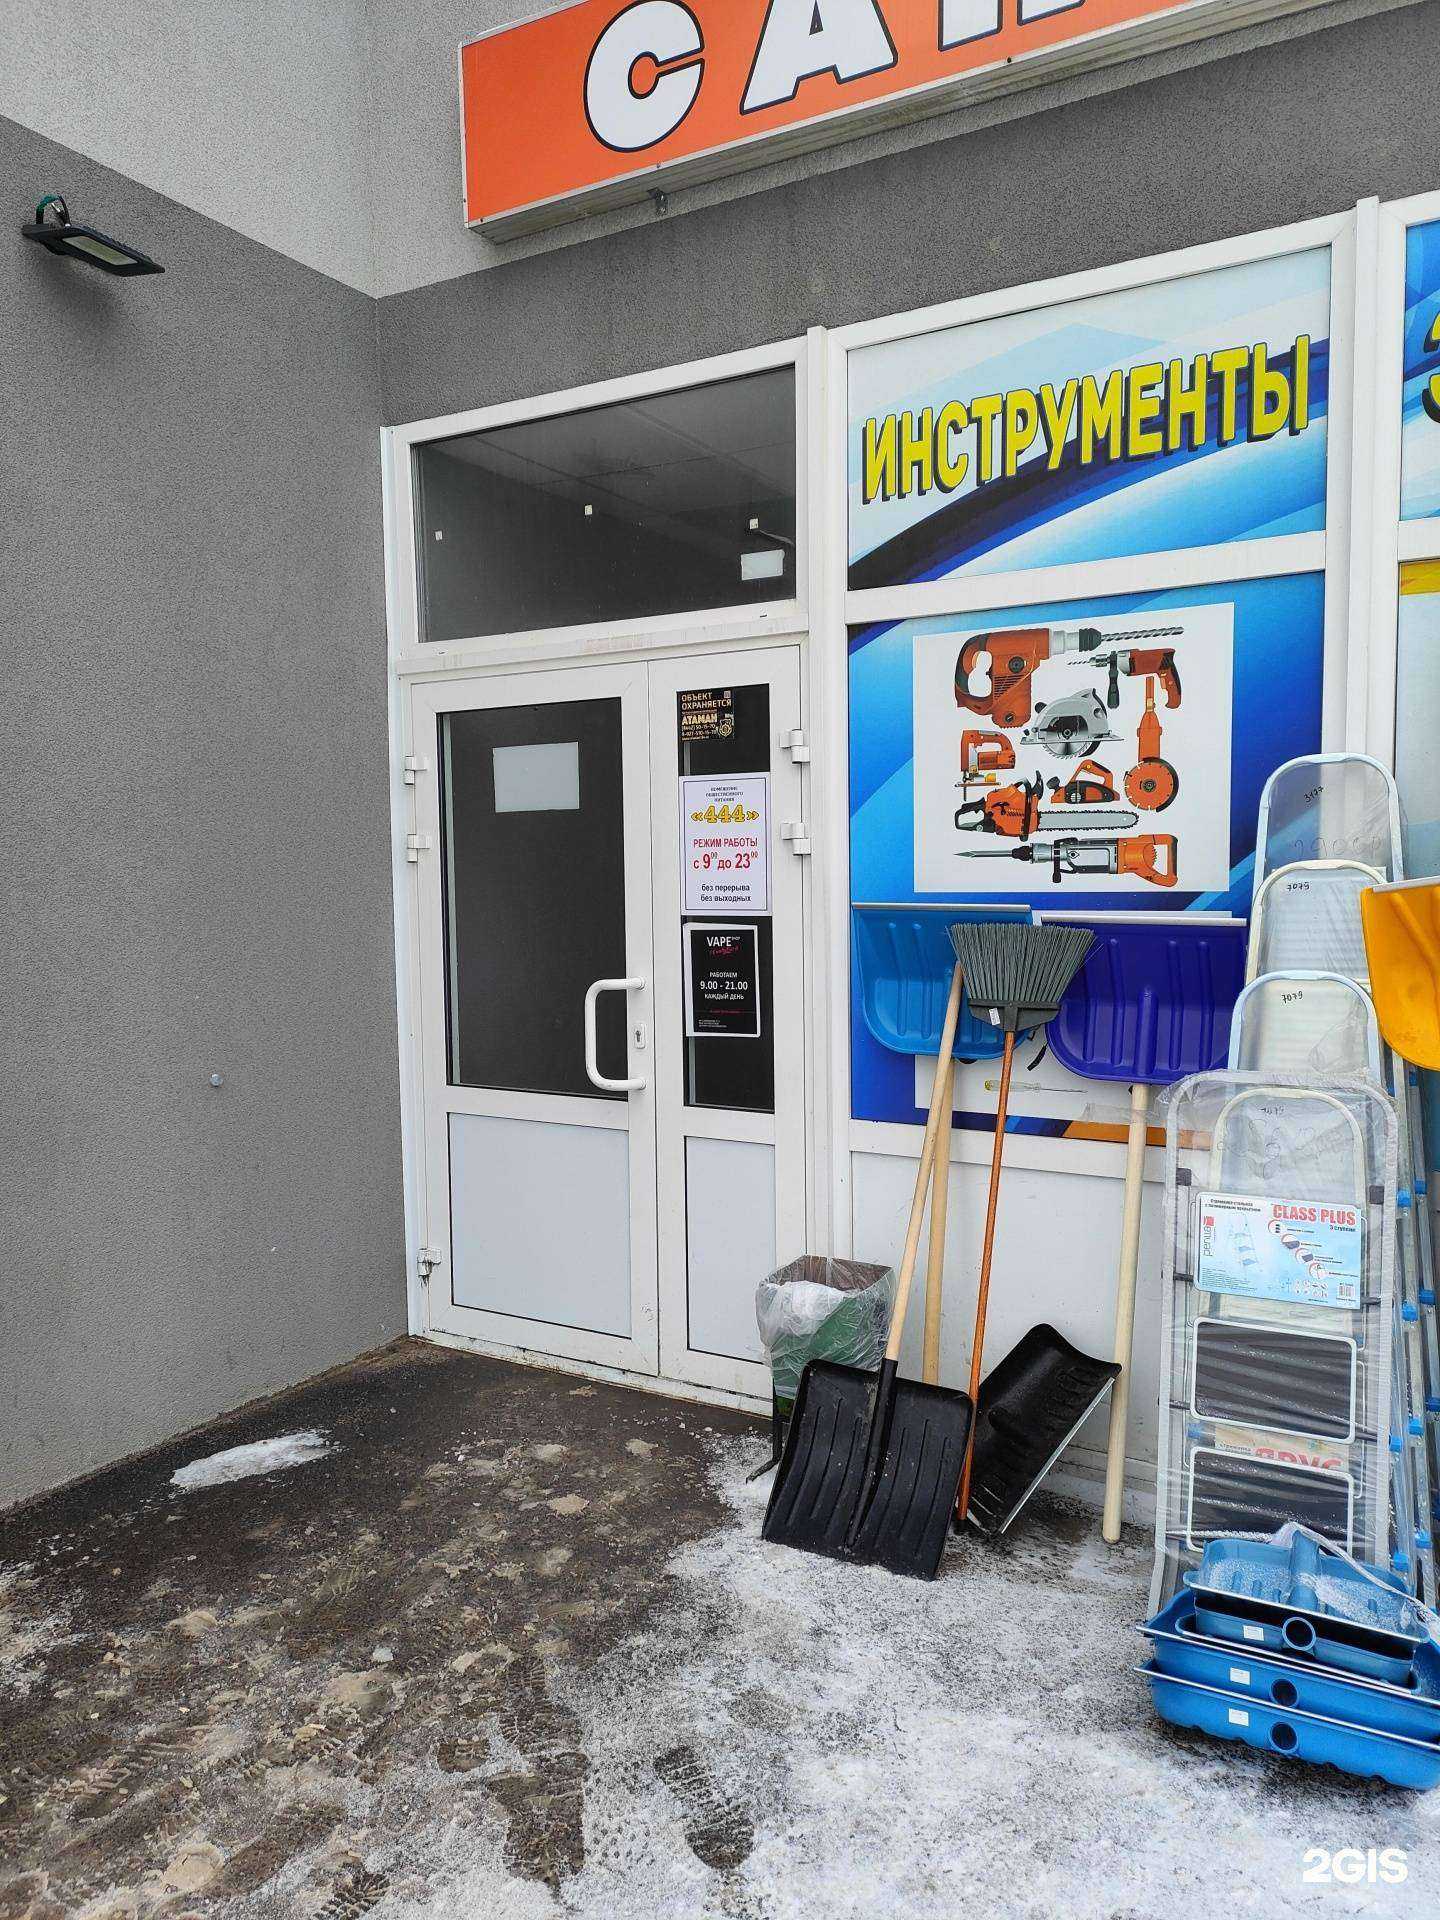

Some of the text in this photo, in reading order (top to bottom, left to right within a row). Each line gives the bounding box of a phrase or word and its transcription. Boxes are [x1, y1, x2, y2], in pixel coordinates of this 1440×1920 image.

[862, 334, 1310, 504] ИНСТРУМЕНТЫ
[681, 692, 712, 702] ОБЪЕКТ
[681, 699, 732, 711] ОХРАНЯЕТСЯ
[681, 713, 718, 726] АТАМАН
[693, 837, 758, 848] РЕЖИМ РАБОТЫ
[717, 859, 732, 871] до
[701, 883, 750, 893] без перерыва
[700, 894, 752, 903] без выходных
[706, 936, 732, 947] VAPE
[700, 980, 718, 990] 9.00
[724, 981, 749, 990] 21.00
[704, 993, 745, 1001] КАЖДЫЙ ДЕНЬ
[1273, 1204, 1356, 1226] CLASS PLUS
